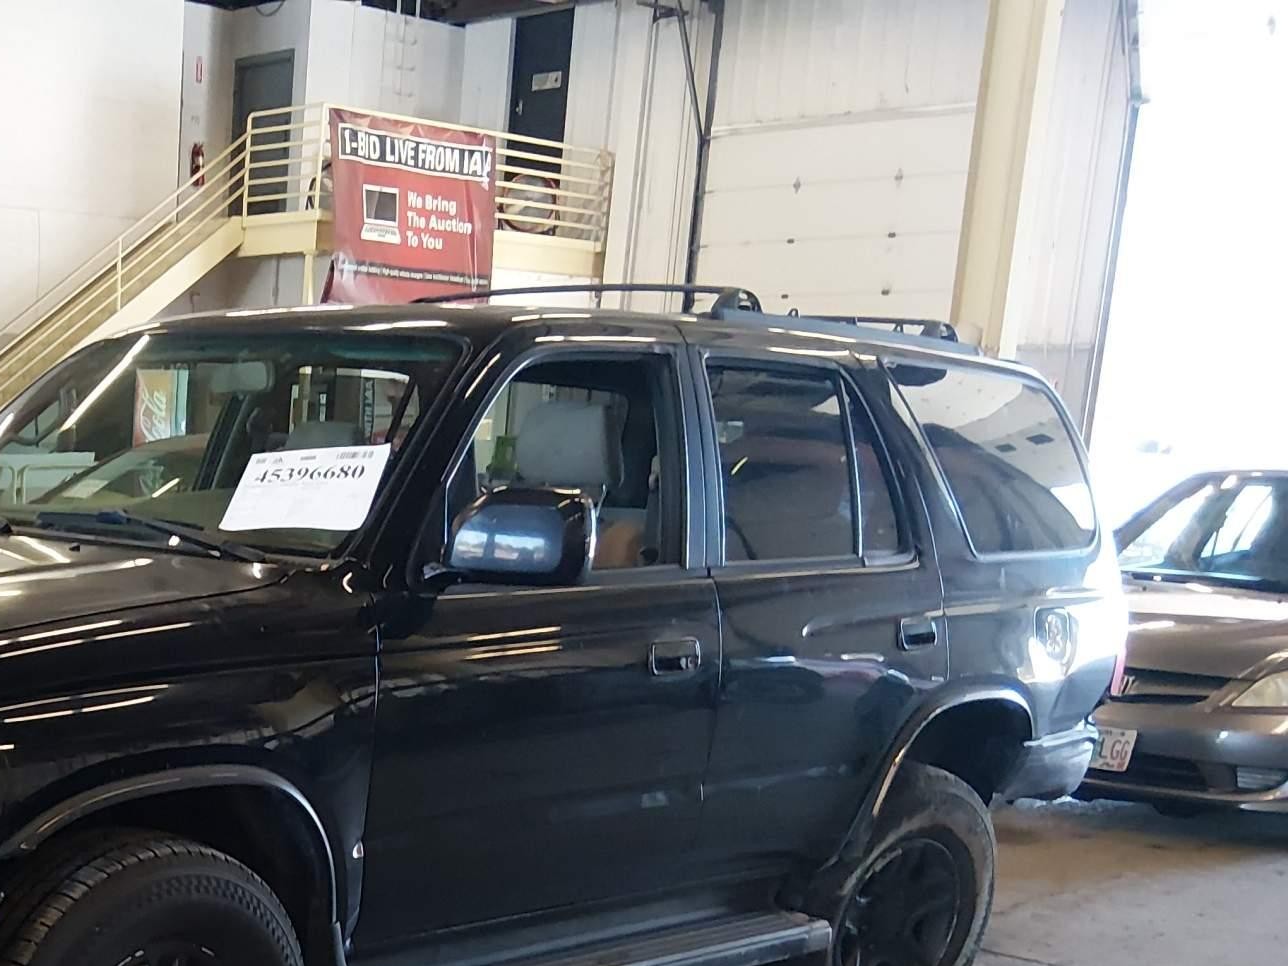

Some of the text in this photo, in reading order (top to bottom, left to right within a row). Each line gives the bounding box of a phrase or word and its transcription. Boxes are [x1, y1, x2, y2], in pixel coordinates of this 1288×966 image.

[385, 137, 416, 165] LIVE
[418, 143, 460, 172] FROM
[407, 190, 457, 217] We Bring
[406, 210, 472, 235] The Auction
[405, 230, 443, 250] To You
[253, 463, 366, 483] 45396680
